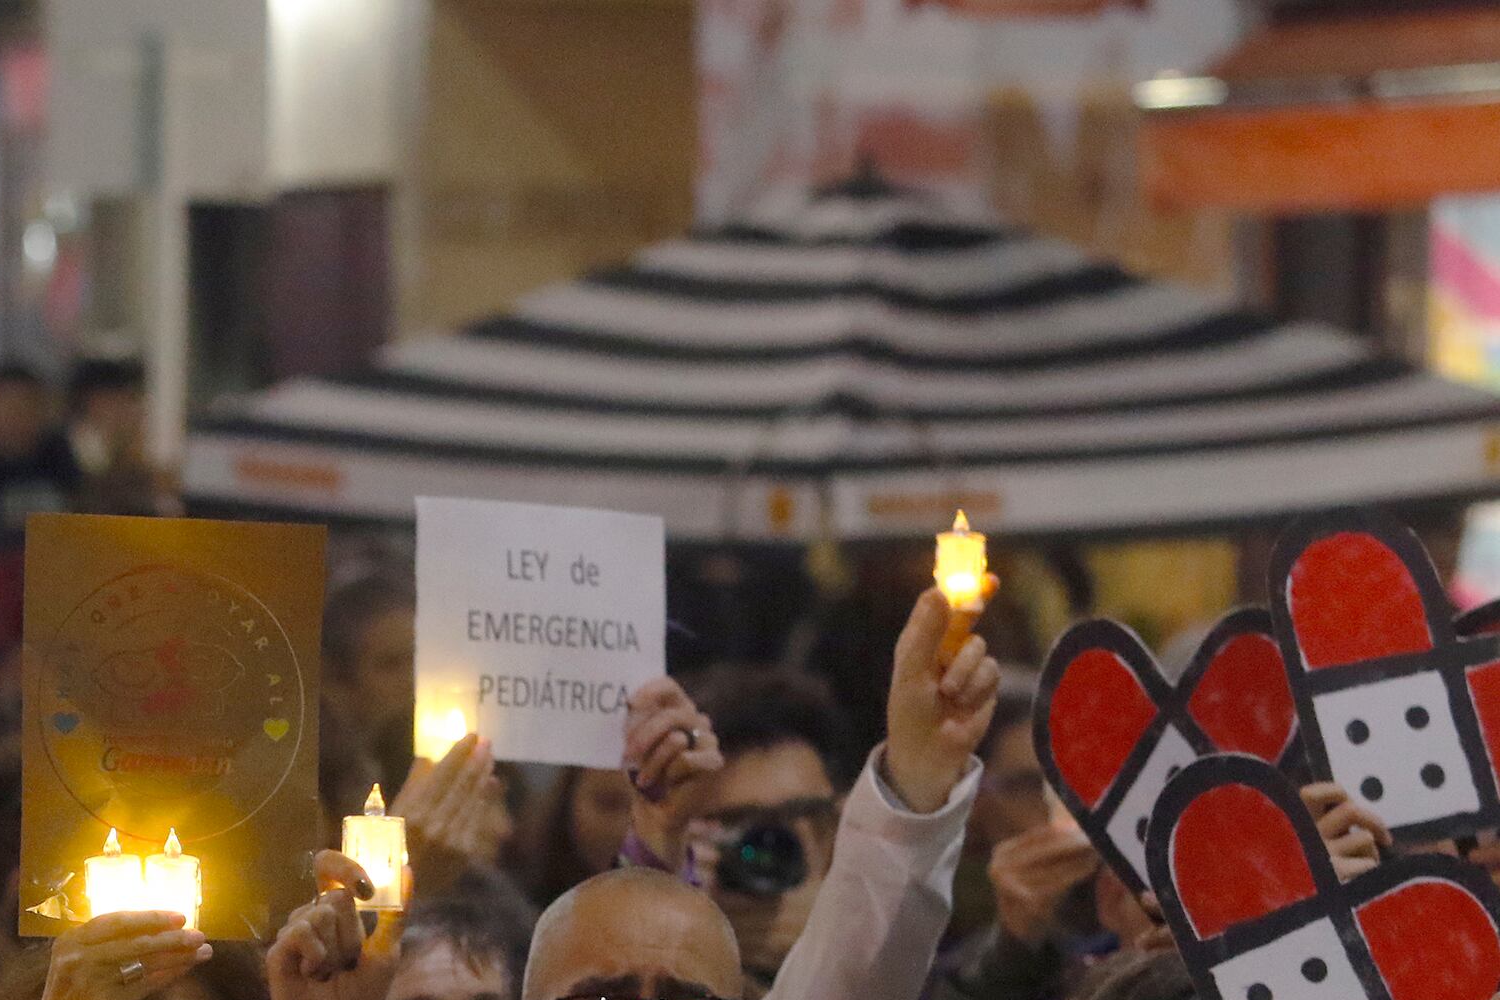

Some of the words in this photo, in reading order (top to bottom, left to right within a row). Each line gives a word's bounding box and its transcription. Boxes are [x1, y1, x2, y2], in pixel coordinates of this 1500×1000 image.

[506, 549, 549, 581] LEY
[570, 554, 600, 587] de
[467, 610, 641, 651] EMERGENCIA
[479, 671, 630, 714] PEDIÁTRICA
